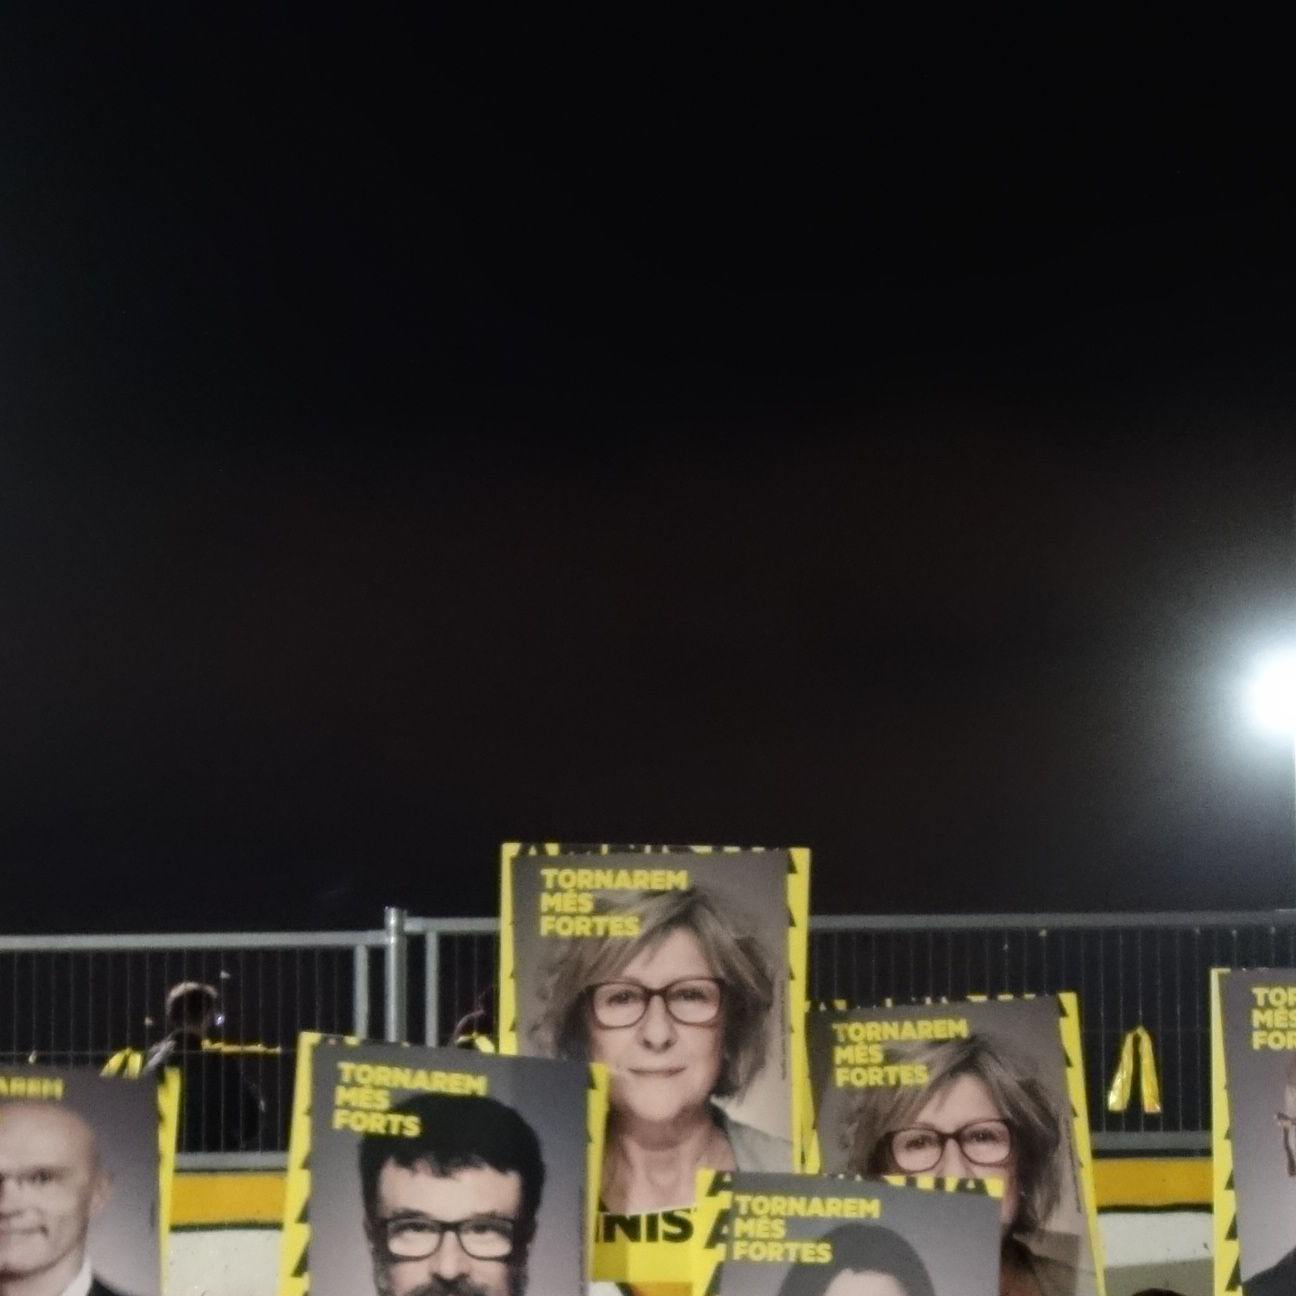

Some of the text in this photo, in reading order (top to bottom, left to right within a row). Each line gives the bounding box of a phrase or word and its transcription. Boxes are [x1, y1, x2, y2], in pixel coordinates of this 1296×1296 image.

[541, 868, 688, 891] TORNAREM
[541, 889, 593, 913] MÉS
[541, 914, 640, 937] FORTES
[832, 1019, 968, 1041] TORNAREM
[834, 1040, 883, 1066] MÉS
[337, 1061, 488, 1096] TORNAREM
[834, 1063, 929, 1088] FORTES
[334, 1083, 392, 1111] MÉS
[332, 1109, 421, 1138] FORTS
[733, 1195, 880, 1220] TORNAREM
[734, 1213, 786, 1239] MÉS
[732, 1241, 832, 1263] FORTES
